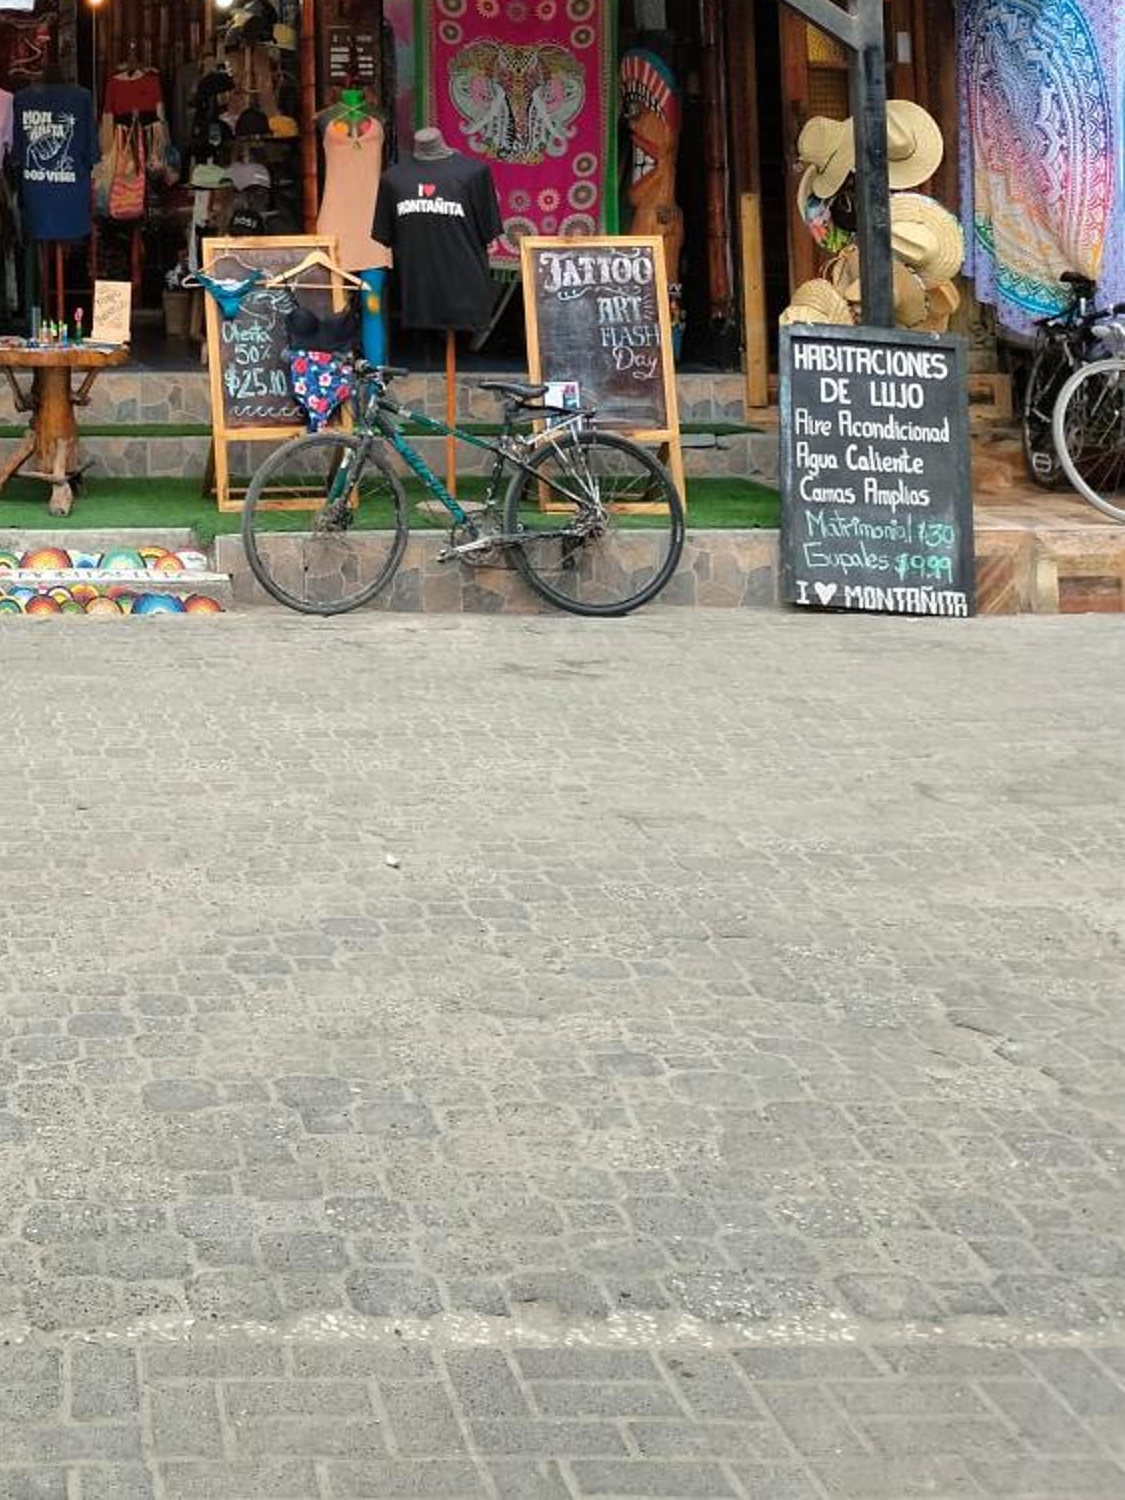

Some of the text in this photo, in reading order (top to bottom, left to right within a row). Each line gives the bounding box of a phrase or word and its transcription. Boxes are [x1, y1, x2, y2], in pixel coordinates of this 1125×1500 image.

[539, 251, 652, 292] TATTOO
[597, 296, 644, 323] ART
[600, 323, 661, 347] FLASH
[821, 378, 925, 409] DE LUJO
[795, 408, 833, 437] Aire
[795, 442, 925, 477] Agua Caliente
[800, 476, 931, 514] Camas Amplias
